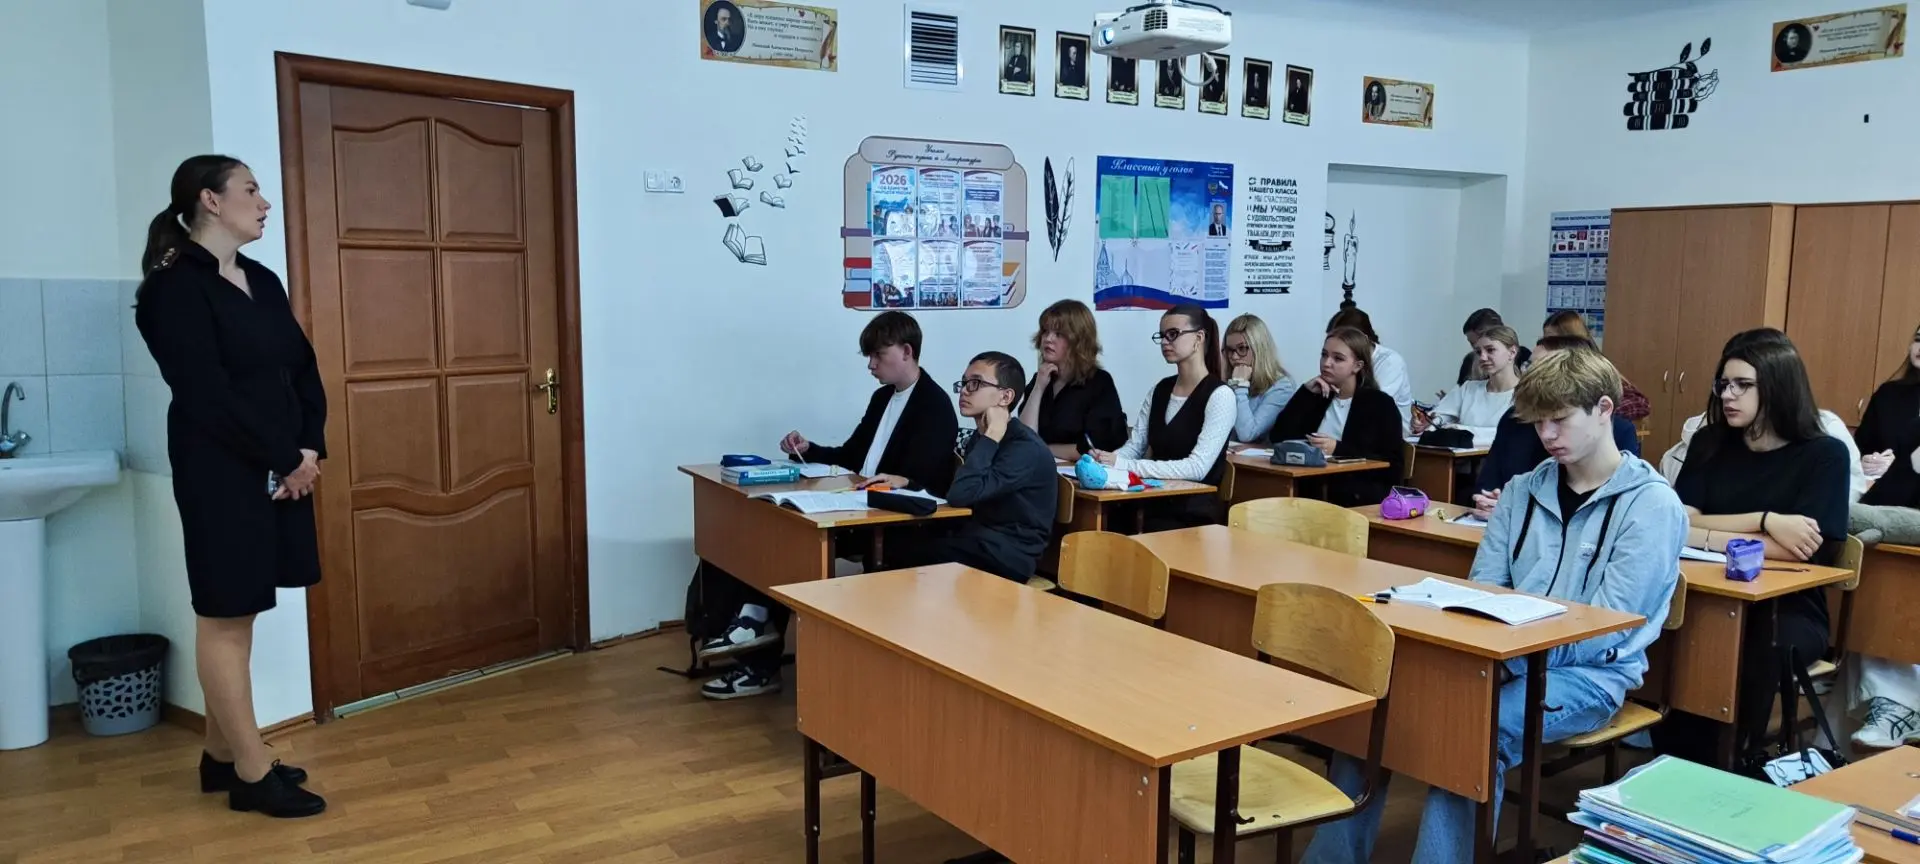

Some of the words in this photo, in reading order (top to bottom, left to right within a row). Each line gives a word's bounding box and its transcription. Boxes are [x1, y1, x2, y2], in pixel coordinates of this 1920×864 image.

[1110, 160, 1160, 172] Классный
[1160, 166, 1194, 176] уголок
[880, 174, 907, 186] 2026
[1260, 177, 1297, 187] ПРАВИЛА
[1253, 204, 1268, 213] МЫ
[1270, 205, 1298, 214] УЧИМСЯ
